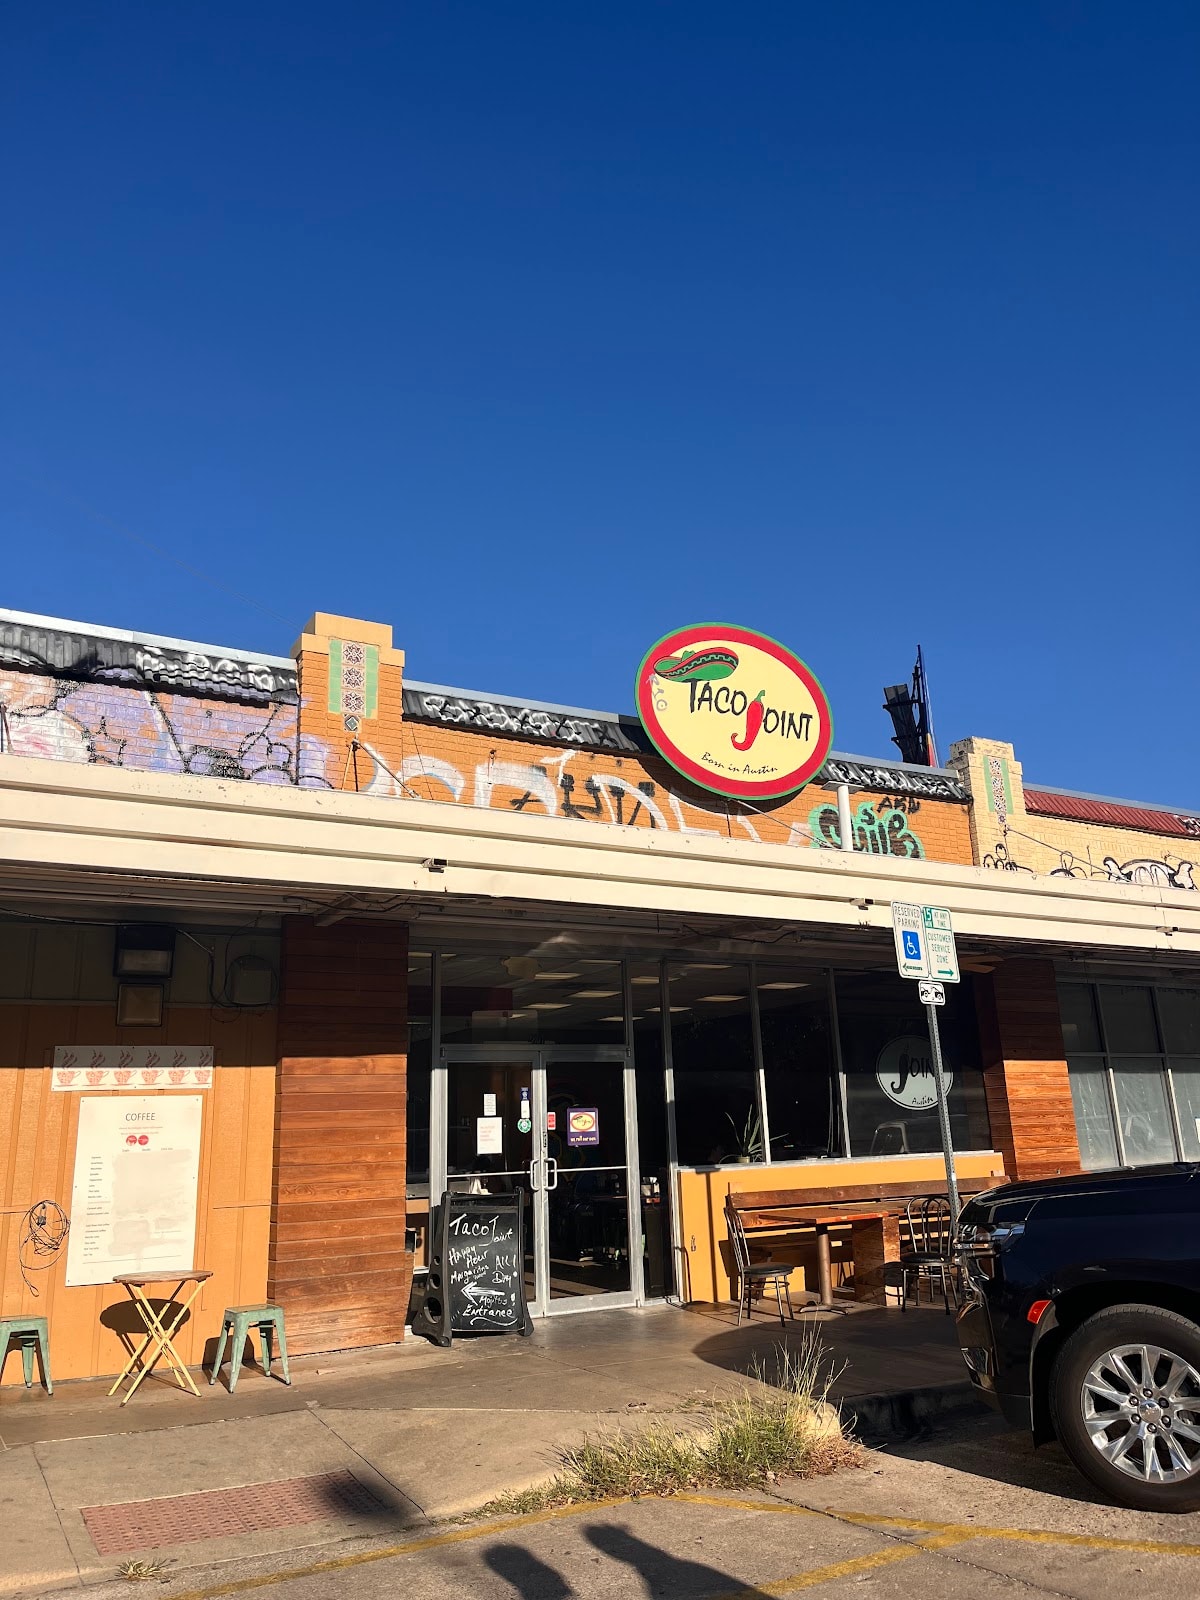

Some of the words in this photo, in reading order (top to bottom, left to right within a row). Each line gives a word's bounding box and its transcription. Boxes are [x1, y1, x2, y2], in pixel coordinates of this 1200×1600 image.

[689, 679, 748, 716] TACO
[731, 690, 813, 751] JOINT
[701, 752, 725, 769] Born
[728, 763, 740, 773] in
[742, 763, 778, 775] Austin
[894, 905, 920, 919] RESERVED
[897, 917, 920, 929] PARKING
[927, 932, 951, 943] CUSTOMER
[931, 943, 951, 954] SERVICE
[936, 954, 949, 964] ZONE
[891, 1053, 937, 1095] JOIN
[125, 1112, 156, 1122] COFFEE
[449, 1213, 490, 1237] Taco
[478, 1215, 513, 1247] Joint
[448, 1245, 477, 1266] Happy
[466, 1250, 488, 1269] Hour
[462, 1303, 516, 1318] Entrance
